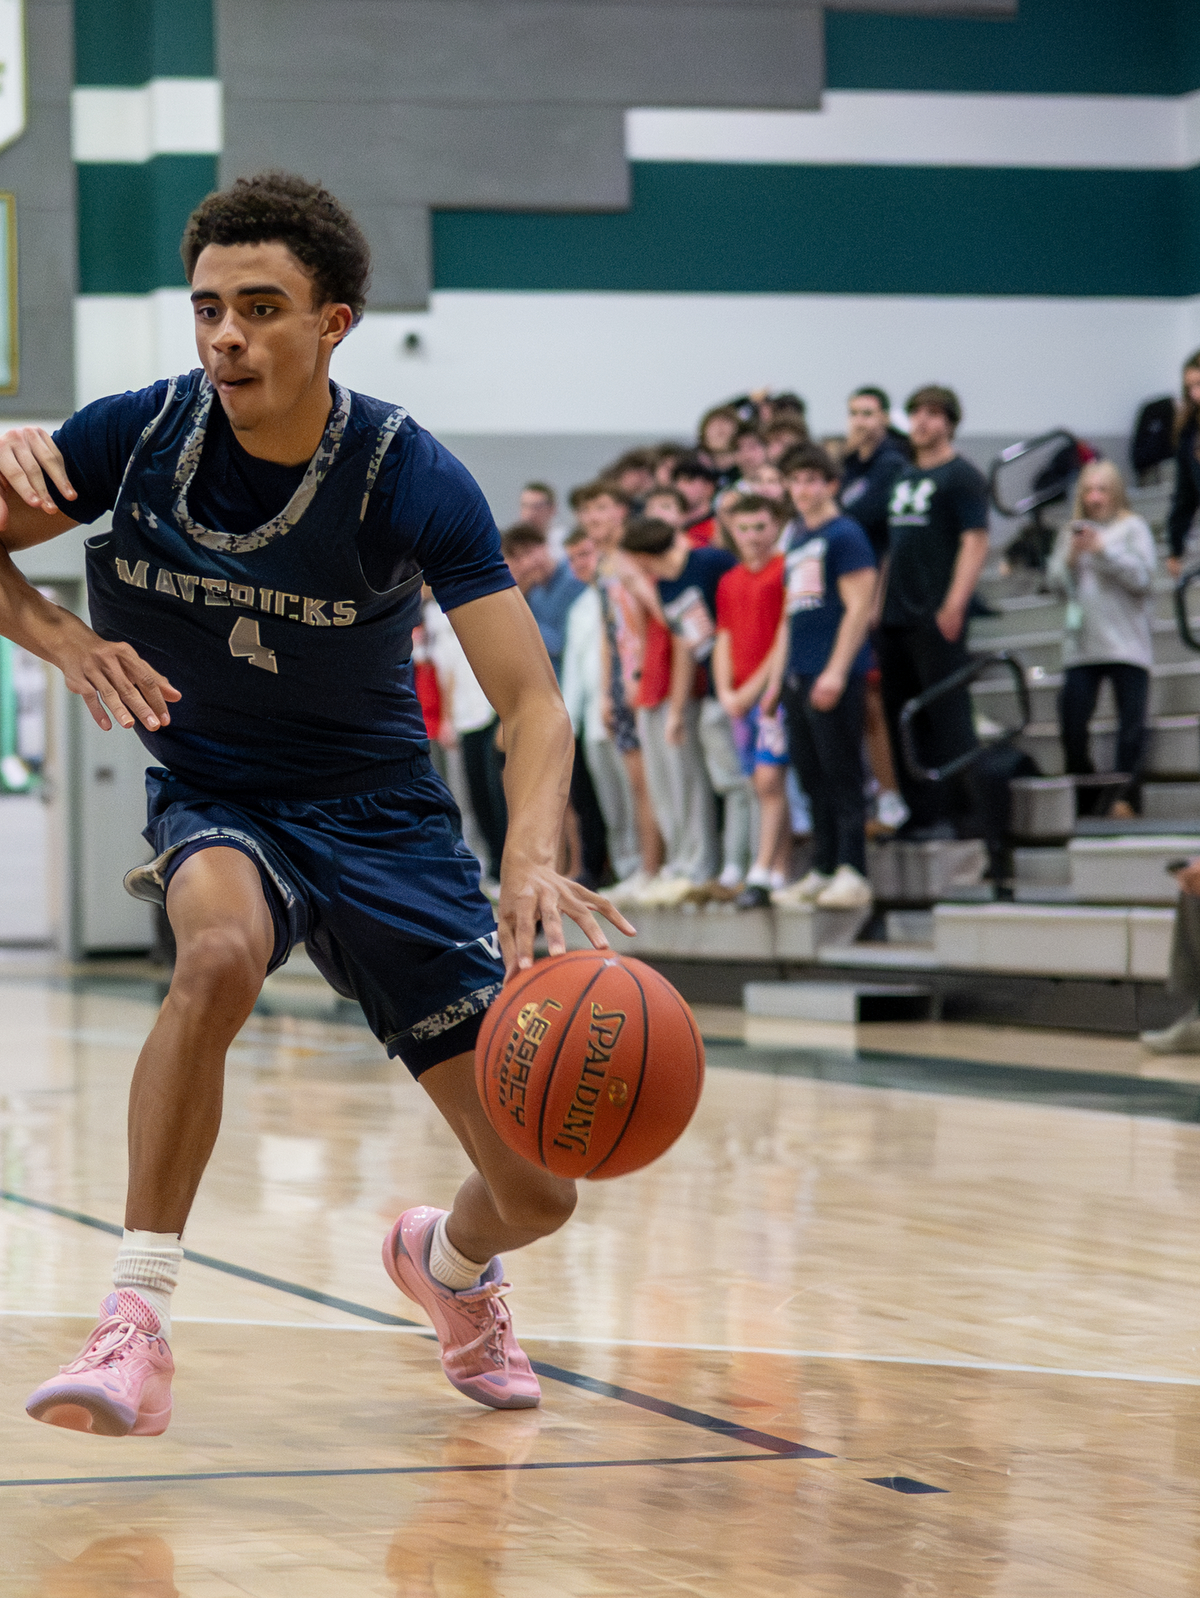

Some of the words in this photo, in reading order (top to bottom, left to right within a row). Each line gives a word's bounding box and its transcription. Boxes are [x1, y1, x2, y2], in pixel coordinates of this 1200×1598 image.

[115, 557, 358, 627] MAVERICKS
[228, 616, 279, 674] 4
[509, 997, 563, 1127] LEGACY
[553, 1002, 627, 1156] SPALDING
